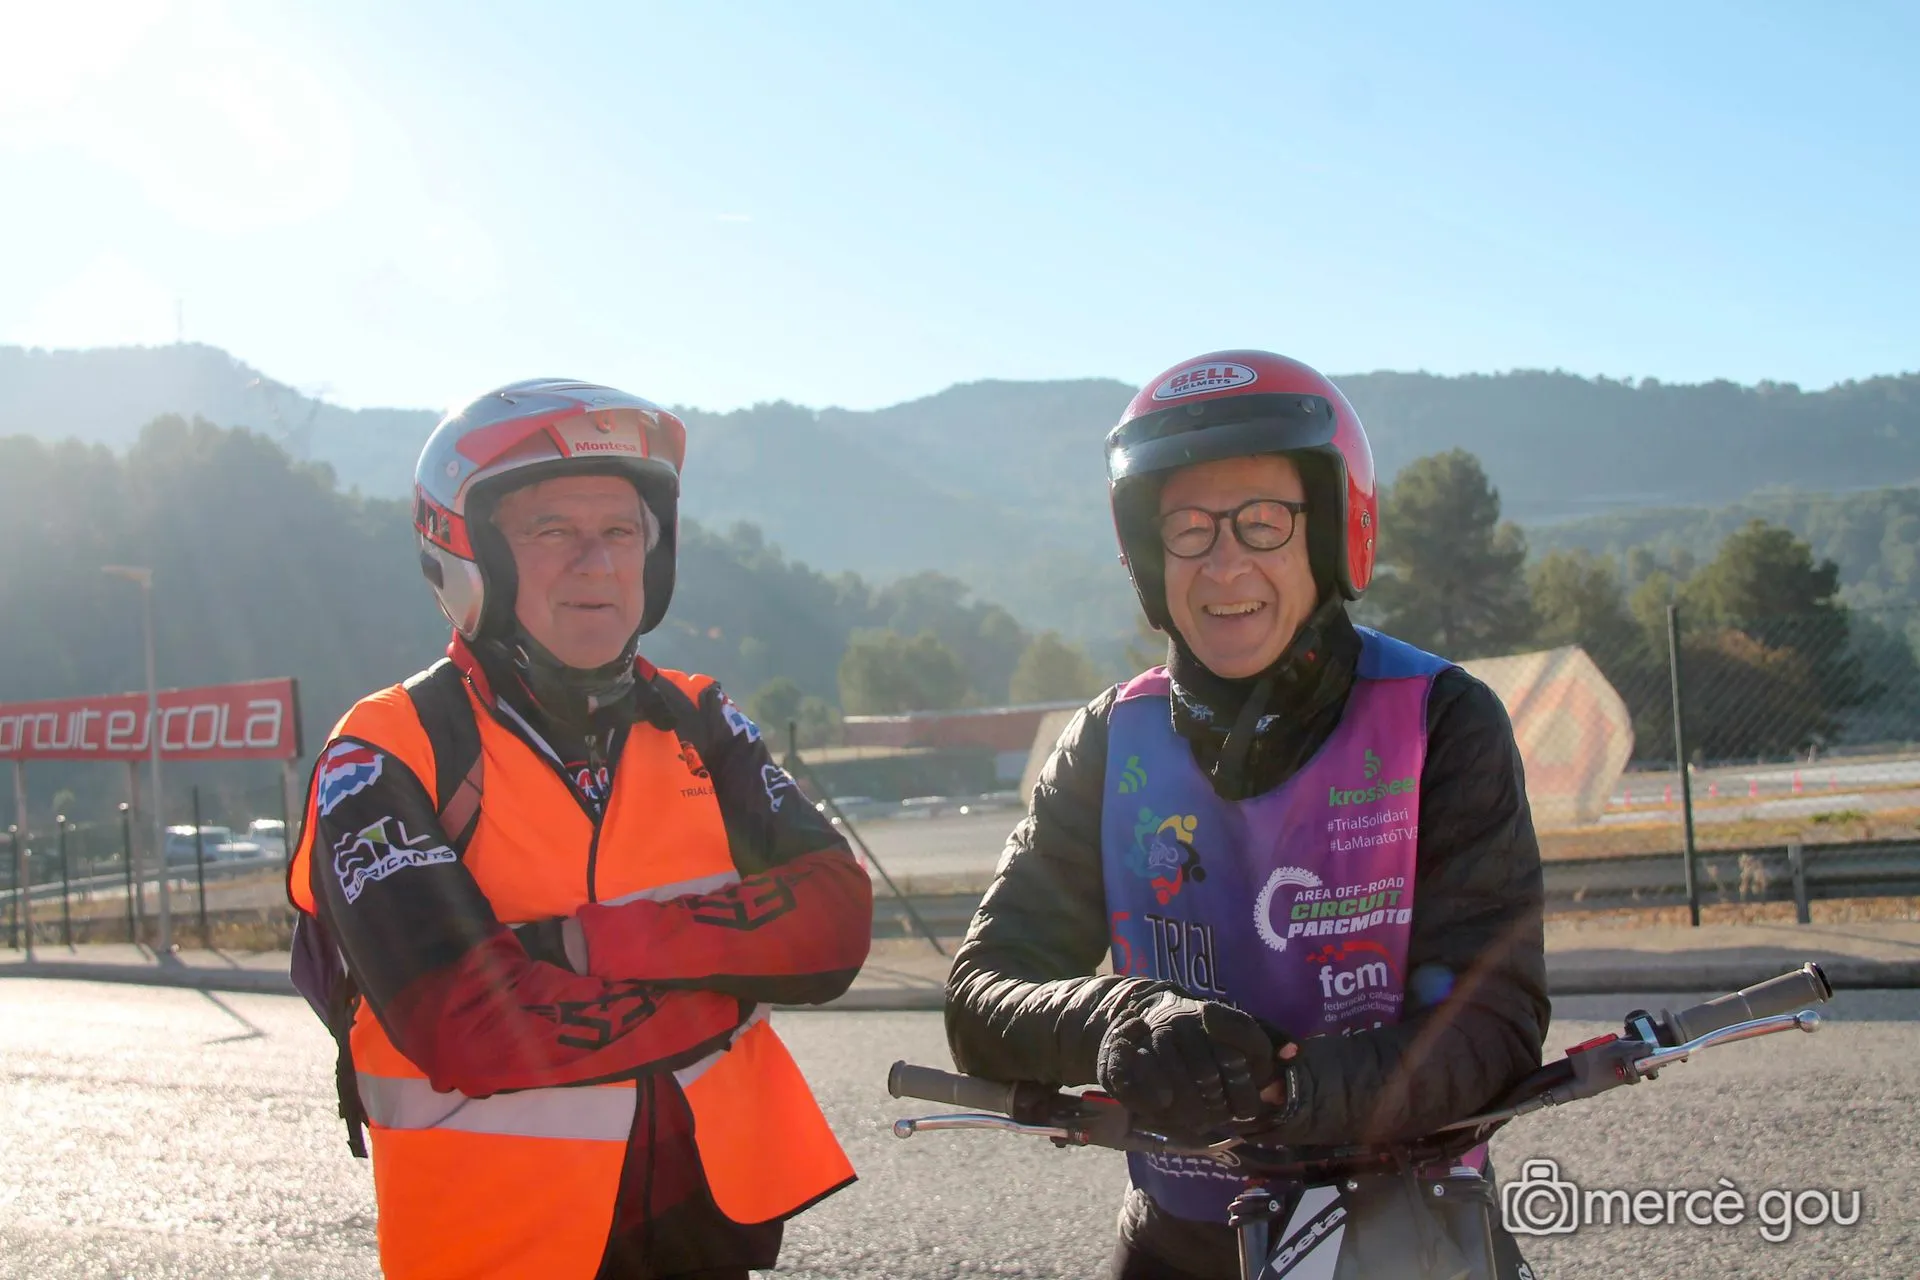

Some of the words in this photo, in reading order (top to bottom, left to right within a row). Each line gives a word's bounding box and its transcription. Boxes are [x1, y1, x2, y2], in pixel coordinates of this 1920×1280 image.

[1170, 367, 1240, 389] BELL
[1174, 378, 1231, 393] HELMETS
[575, 441, 637, 453] Montesa
[1327, 807, 1409, 832] #TrialSolidari
[345, 848, 455, 901] LUBRICANTS
[1294, 888, 1332, 902] AREA
[1335, 877, 1404, 898] OFF-ROAD
[1291, 890, 1402, 920] CIRCUIT
[1288, 908, 1411, 939] PARCMOTO
[1319, 962, 1388, 998] fcm
[1324, 1011, 1338, 1022] de
[1271, 1206, 1348, 1274] Beta
